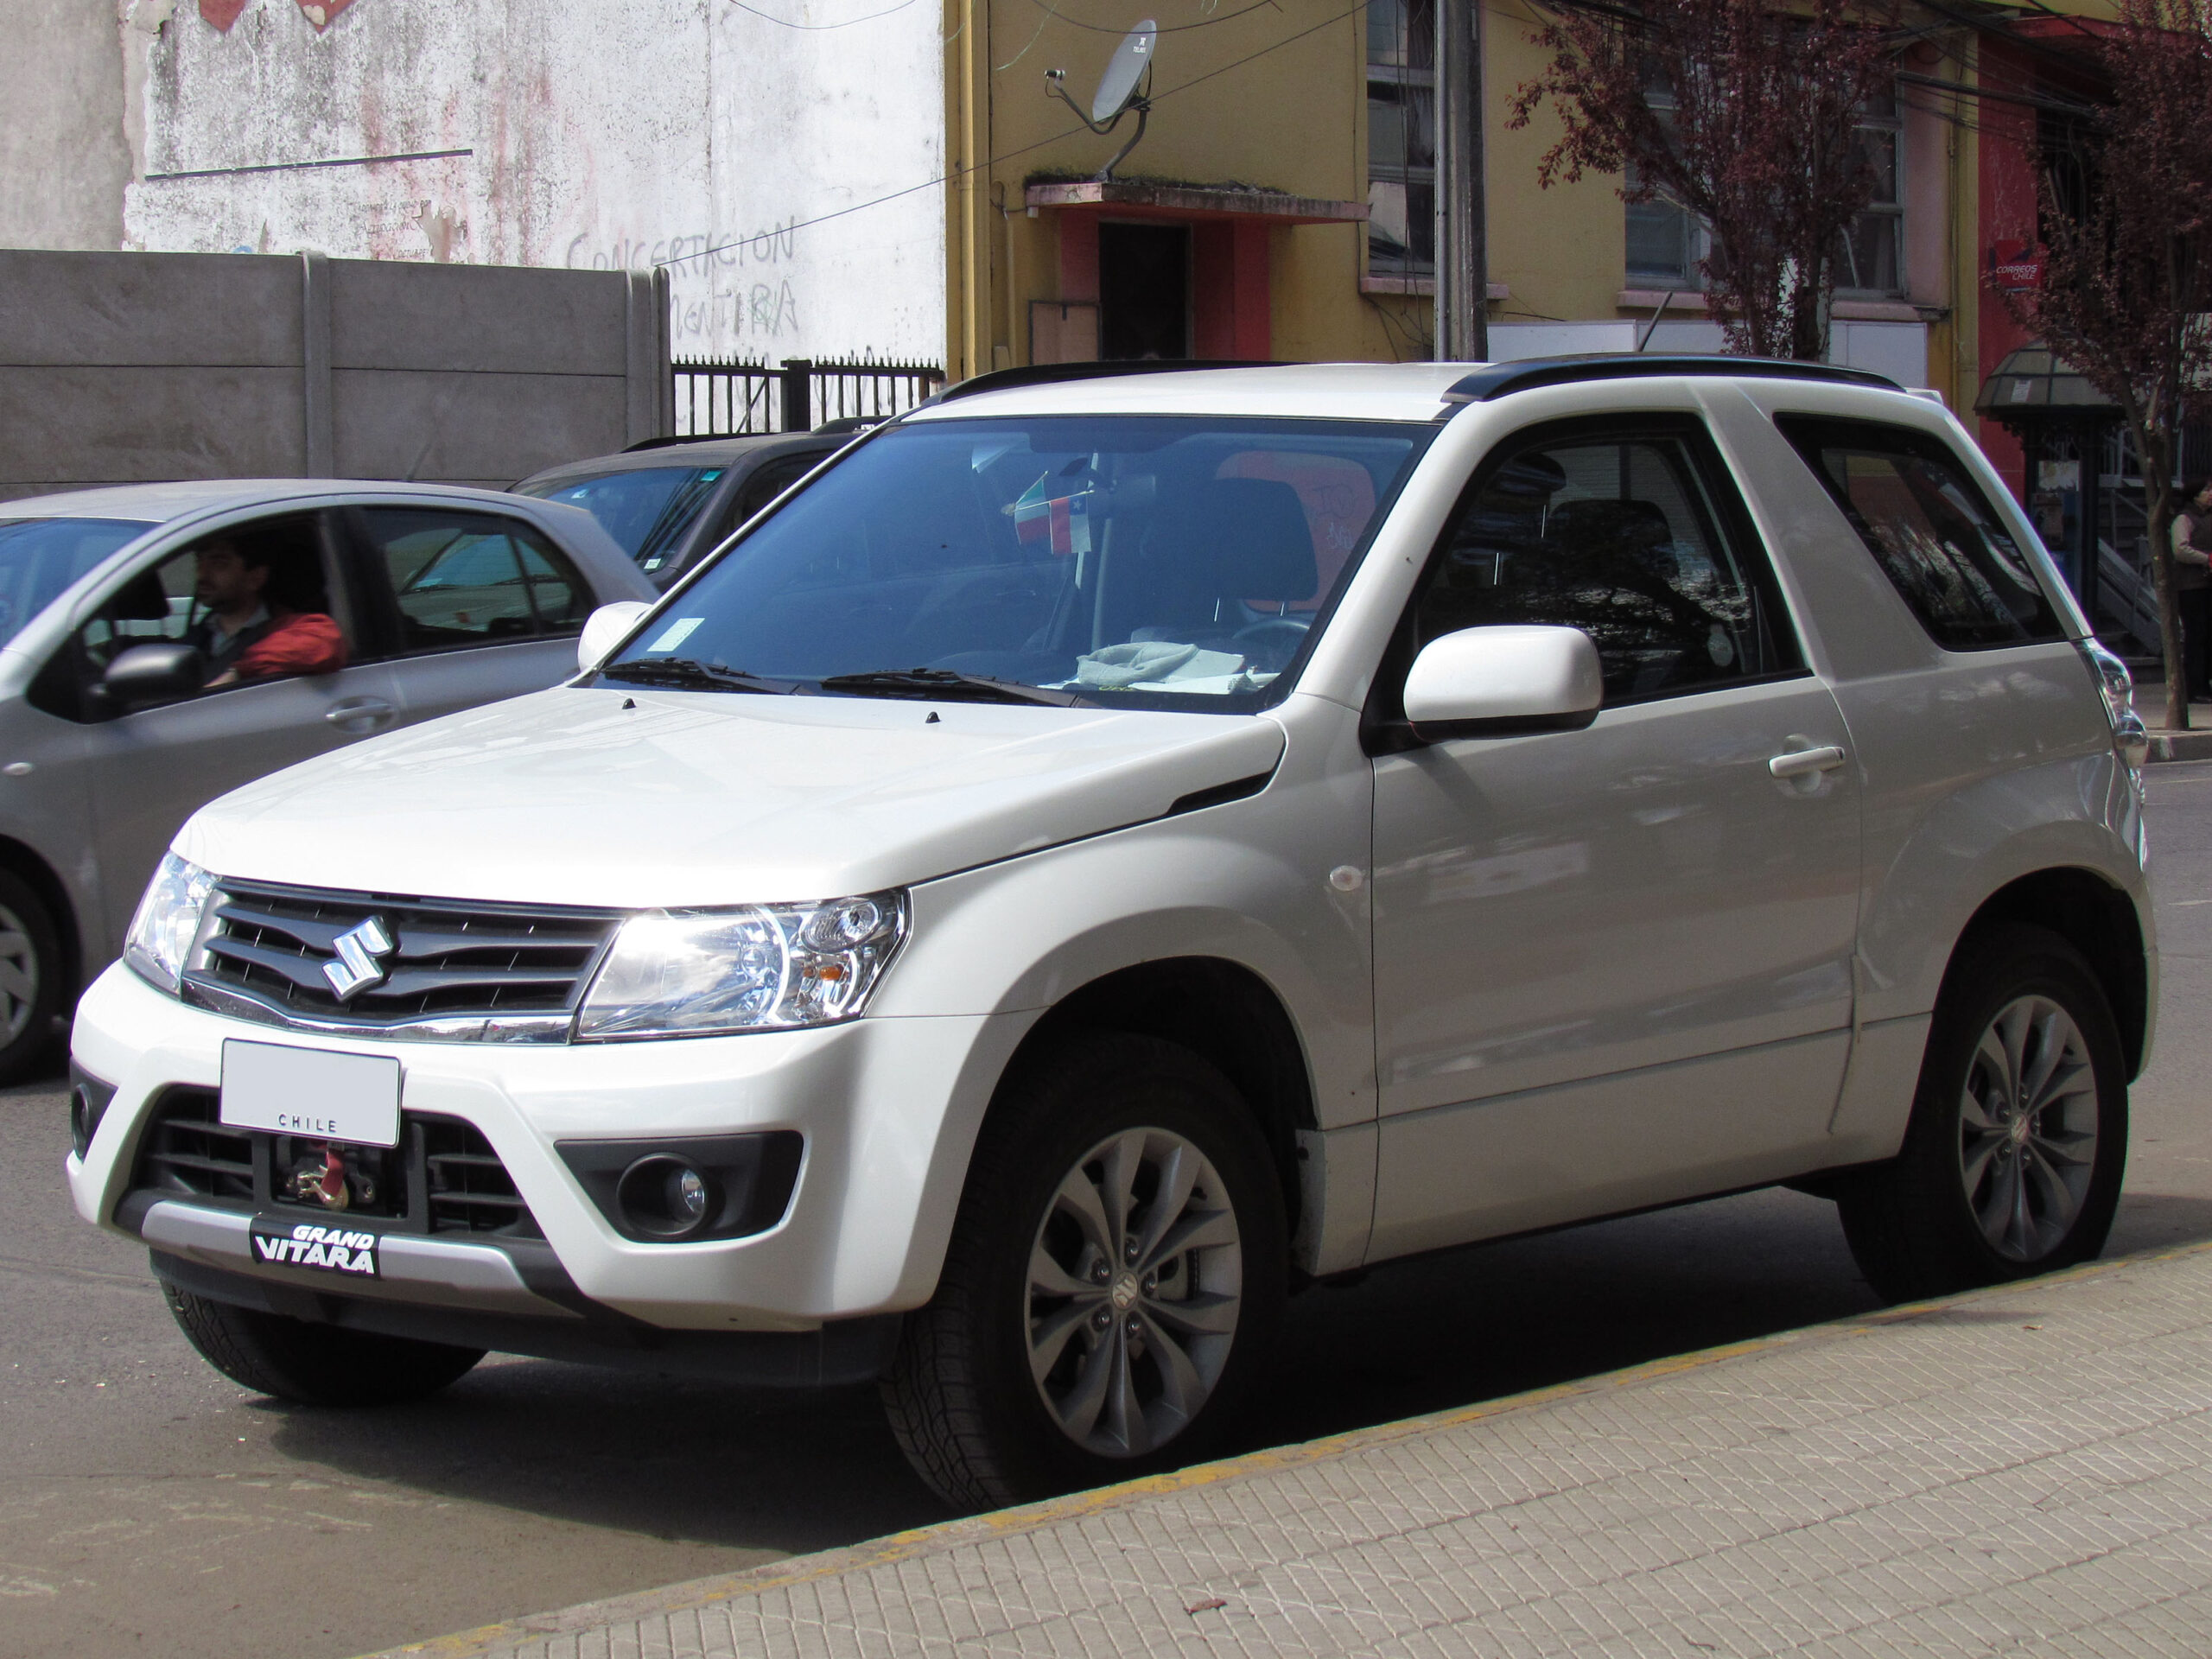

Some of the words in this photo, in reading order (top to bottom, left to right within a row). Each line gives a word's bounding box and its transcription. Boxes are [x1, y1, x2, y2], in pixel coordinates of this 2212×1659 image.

[1996, 264, 2037, 274] CORREOS
[2012, 272, 2036, 281] CHILE
[278, 1114, 337, 1133] CHILE
[292, 1224, 376, 1249] GRAND
[254, 1236, 375, 1274] VITARA
